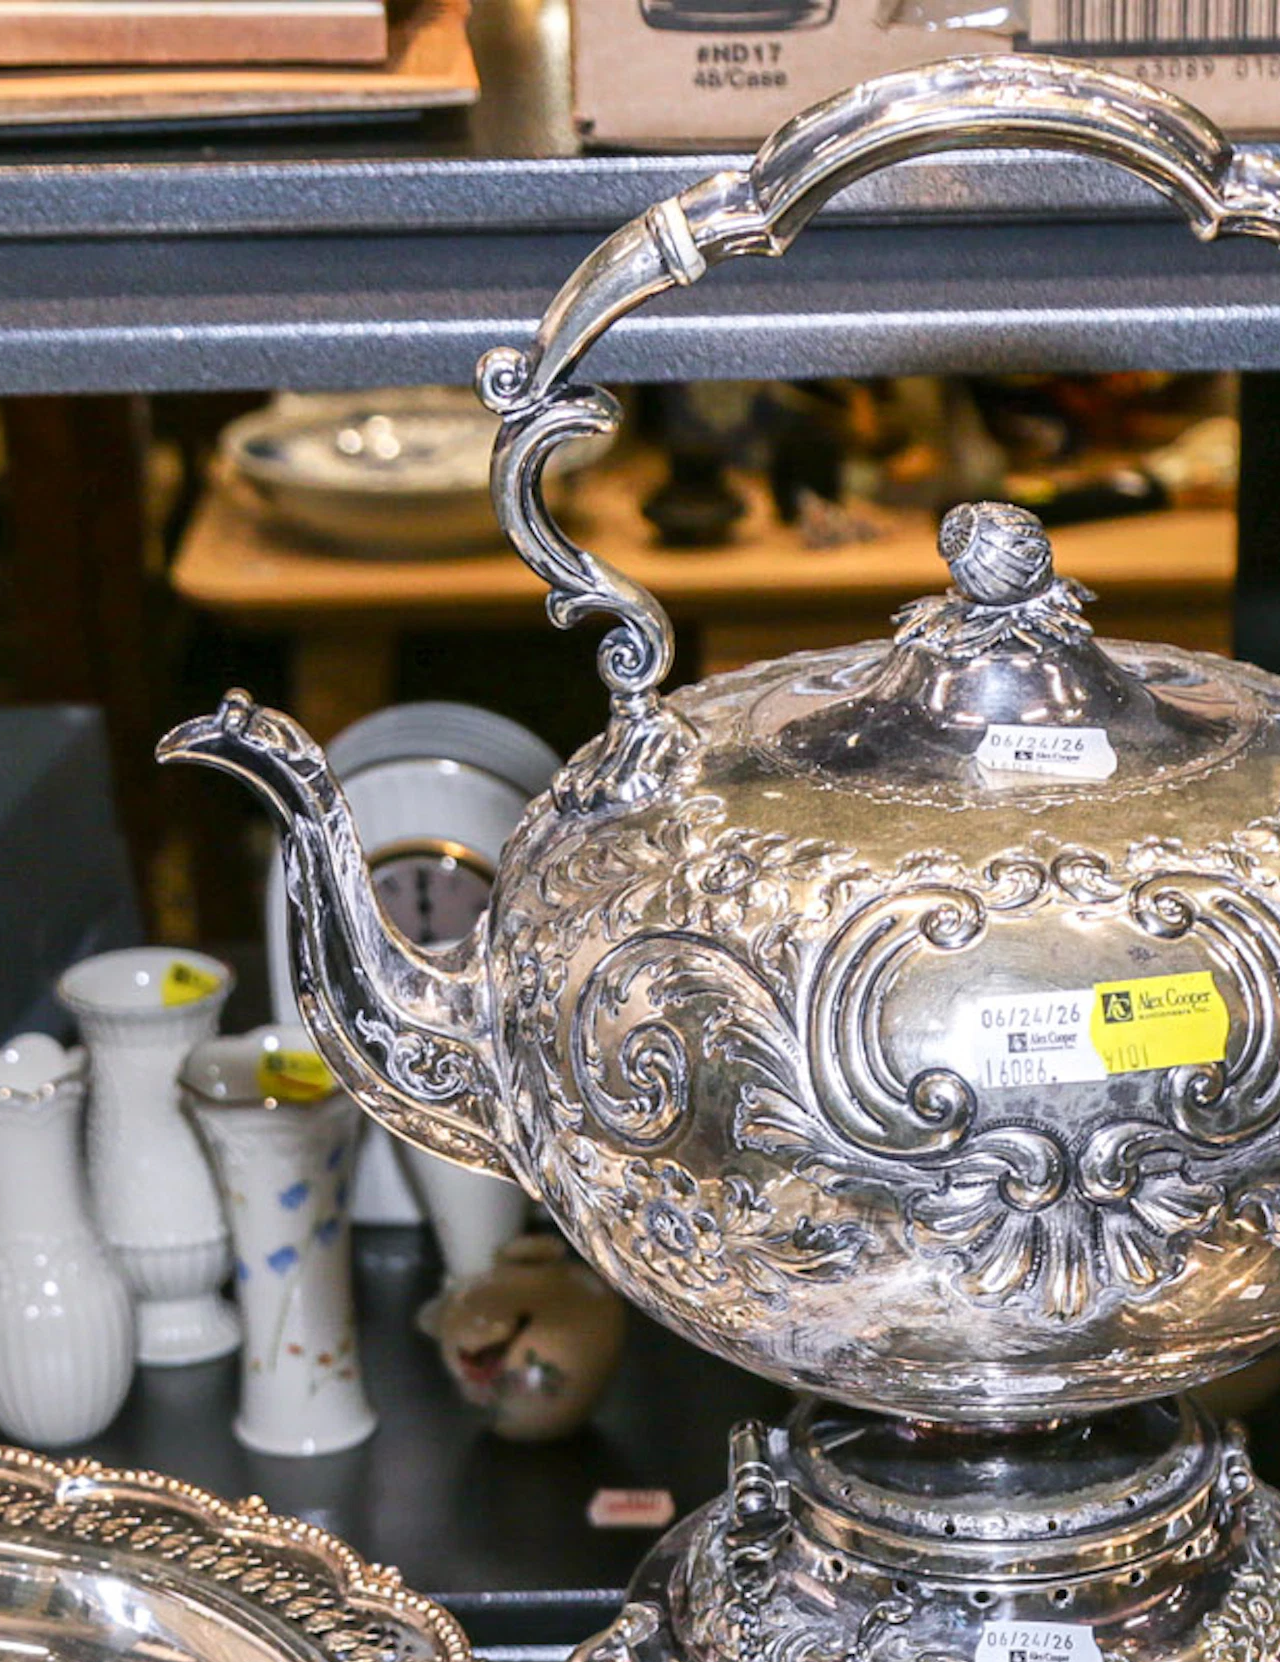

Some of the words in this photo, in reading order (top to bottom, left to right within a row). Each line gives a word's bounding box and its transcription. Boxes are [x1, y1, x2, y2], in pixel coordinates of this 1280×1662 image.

[1138, 991, 1164, 1010] Alex
[1166, 988, 1210, 1010] Cooper
[981, 1003, 1080, 1029] 06/24/26
[987, 1632, 1073, 1650] 06/24/26
